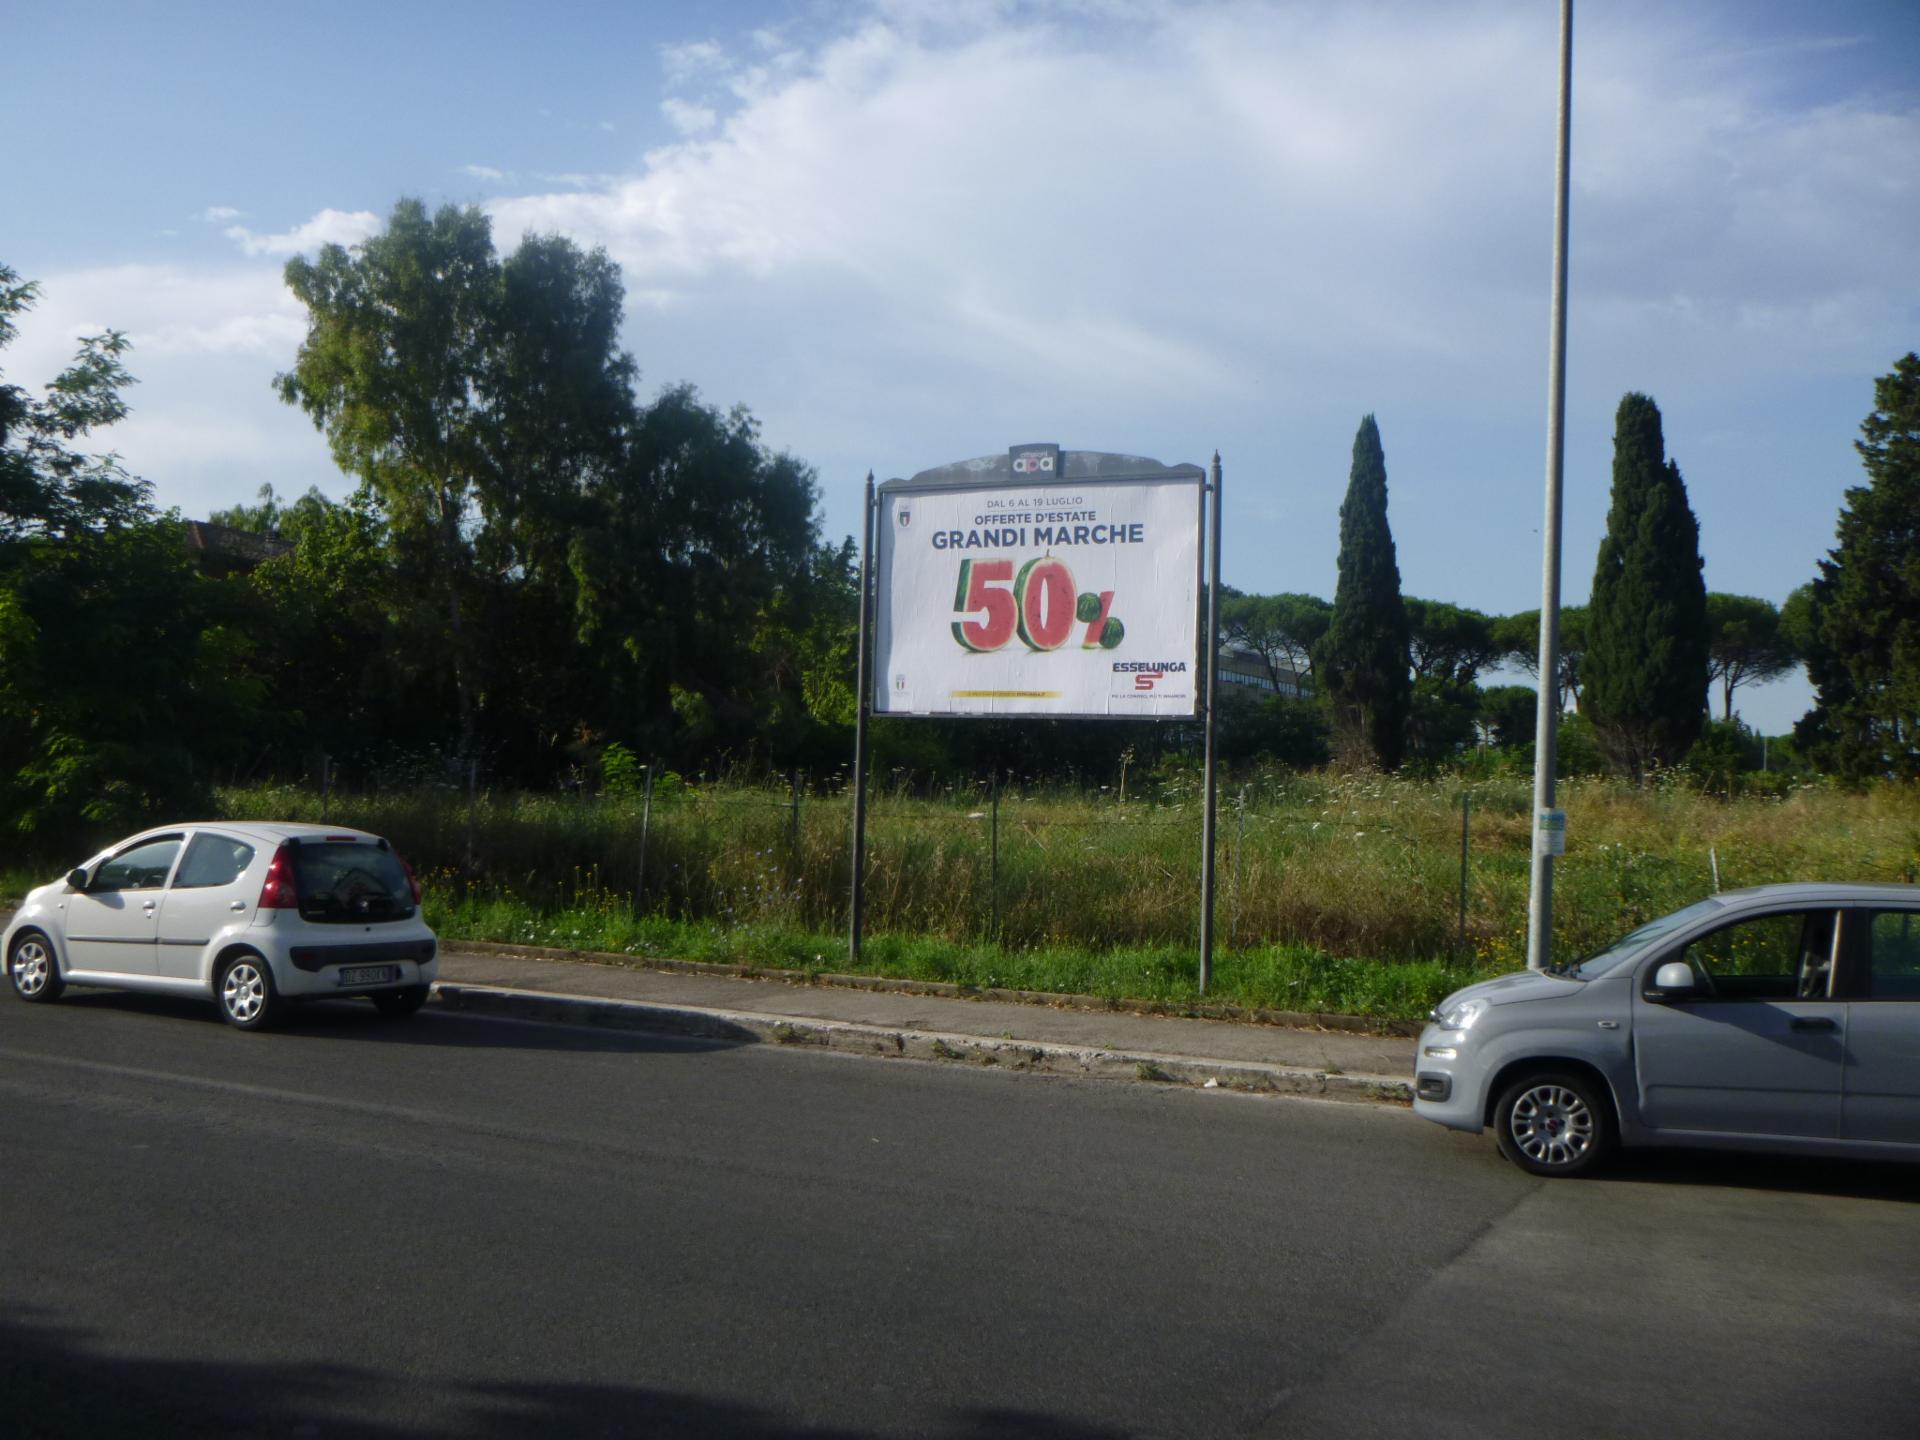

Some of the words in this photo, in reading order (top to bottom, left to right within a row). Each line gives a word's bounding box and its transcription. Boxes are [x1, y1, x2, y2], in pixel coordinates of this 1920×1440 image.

[986, 500, 1006, 509] DAL
[1008, 499, 1015, 508] 6
[1018, 499, 1030, 507] AL
[1034, 498, 1043, 507] 19
[1046, 496, 1083, 506] LUGLIO
[974, 513, 1032, 526] OFFERTE
[1035, 511, 1097, 523] D'ESTATE
[932, 527, 1026, 549] GRANDI
[1034, 523, 1144, 546] MARCHE
[951, 557, 1124, 651] 50%
[1112, 662, 1187, 673] ESSELUNGA
